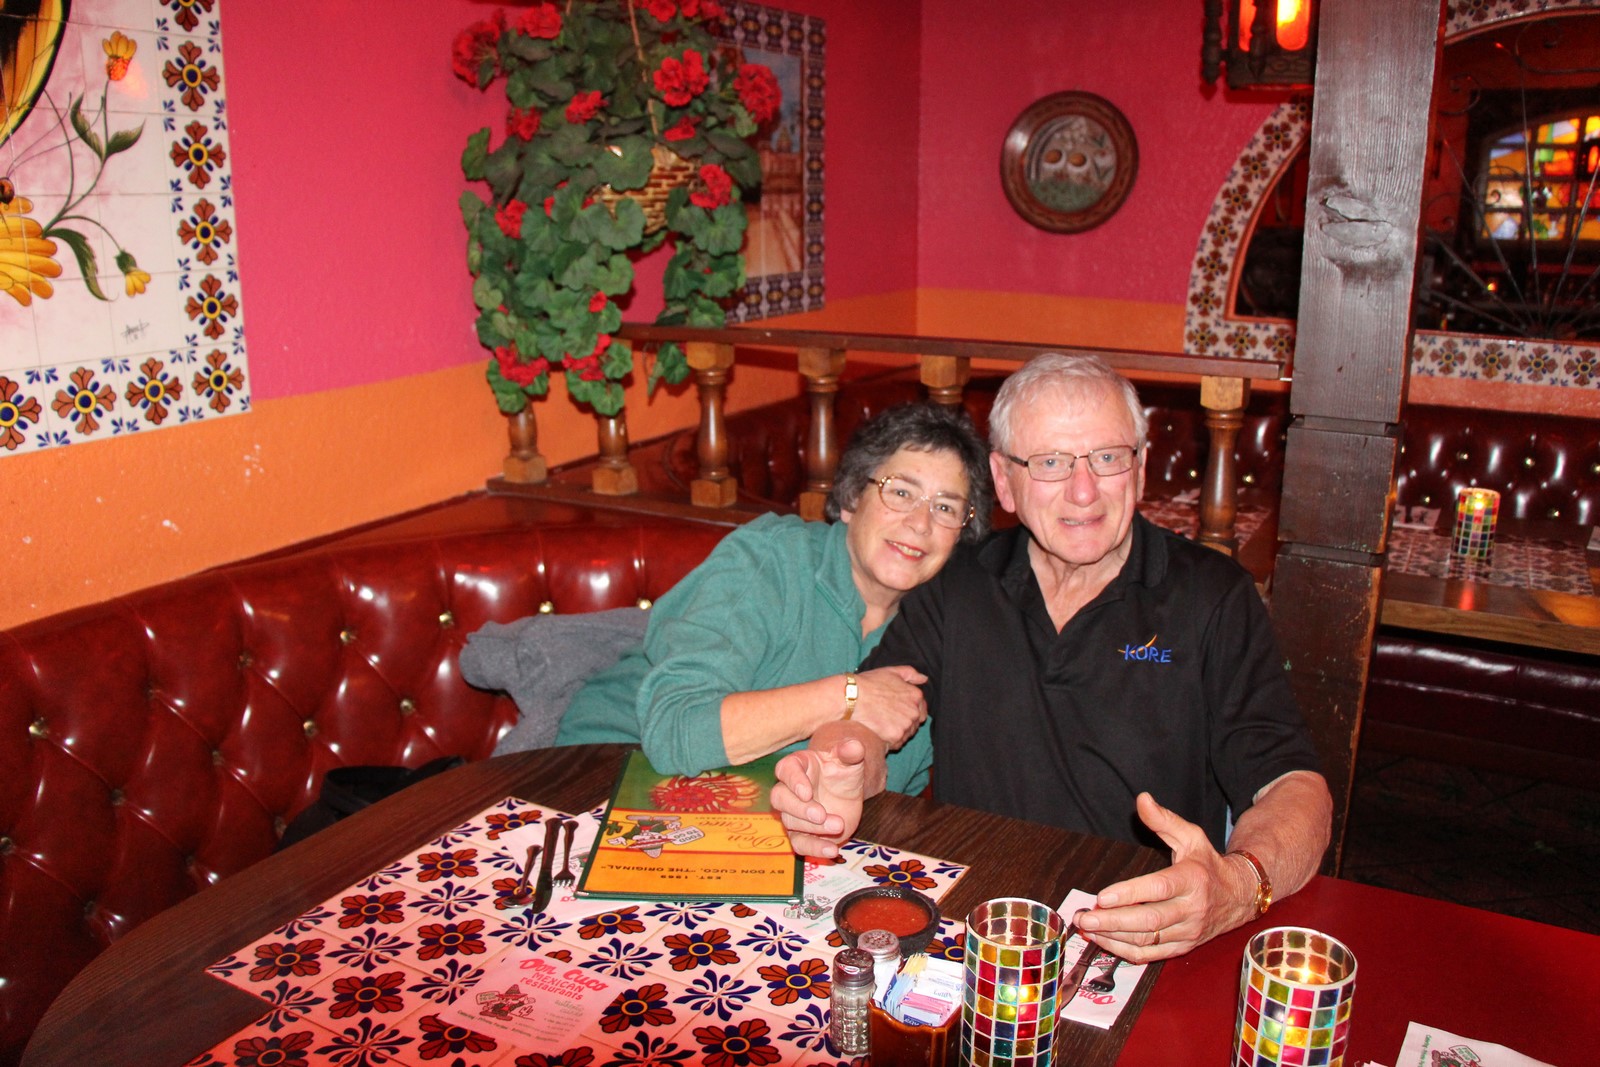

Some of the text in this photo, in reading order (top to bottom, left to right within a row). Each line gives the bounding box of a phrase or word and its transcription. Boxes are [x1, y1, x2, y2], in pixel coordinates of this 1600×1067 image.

[1124, 644, 1172, 663] KORE
[673, 832, 686, 840] GO
[700, 821, 758, 835] Cuco
[678, 833, 702, 843] FOOD
[728, 835, 788, 850] Don
[519, 958, 609, 991] Don Cuco
[531, 972, 585, 993] MEXICAN
[520, 977, 584, 1000] restaurants
[1078, 989, 1116, 1005] Don
